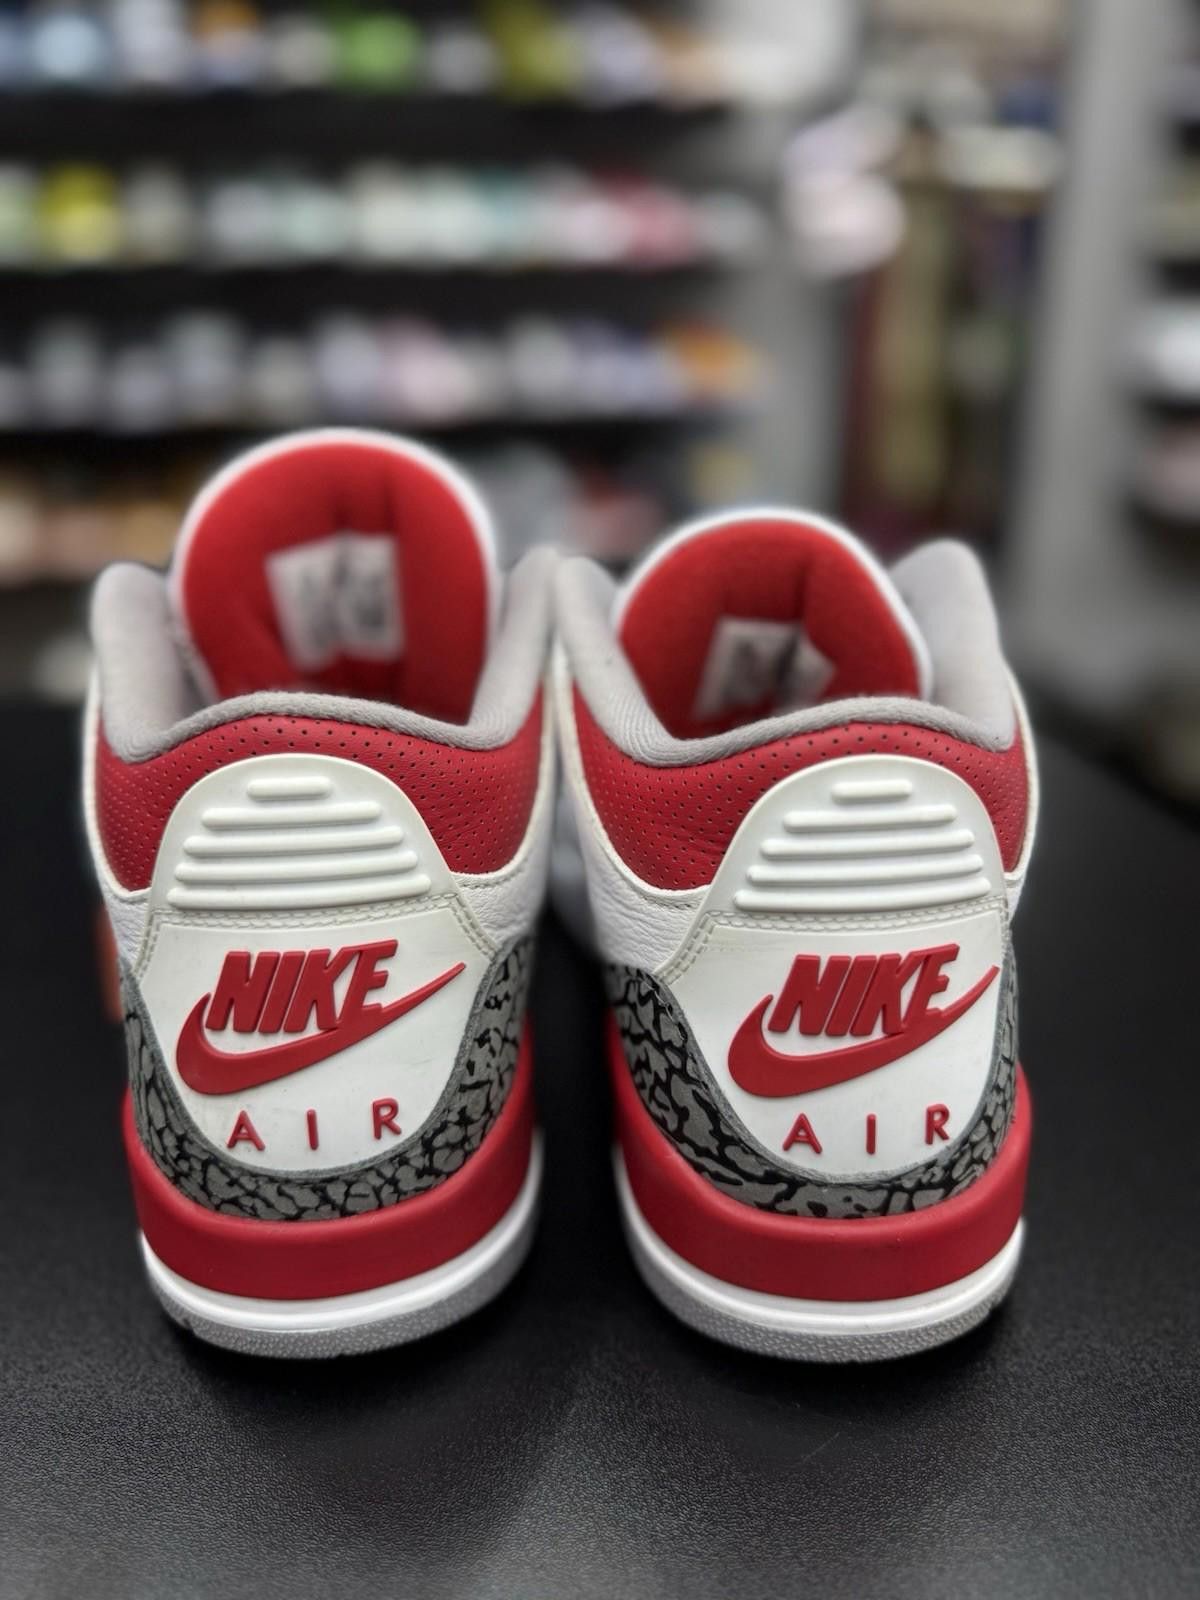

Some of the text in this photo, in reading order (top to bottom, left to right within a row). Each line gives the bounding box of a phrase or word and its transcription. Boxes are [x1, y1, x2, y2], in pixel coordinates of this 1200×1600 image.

[205, 939, 398, 1033] NIKE
[768, 943, 960, 1037] NIKE
[226, 1098, 402, 1151] AIR
[783, 1103, 950, 1155] AIR
